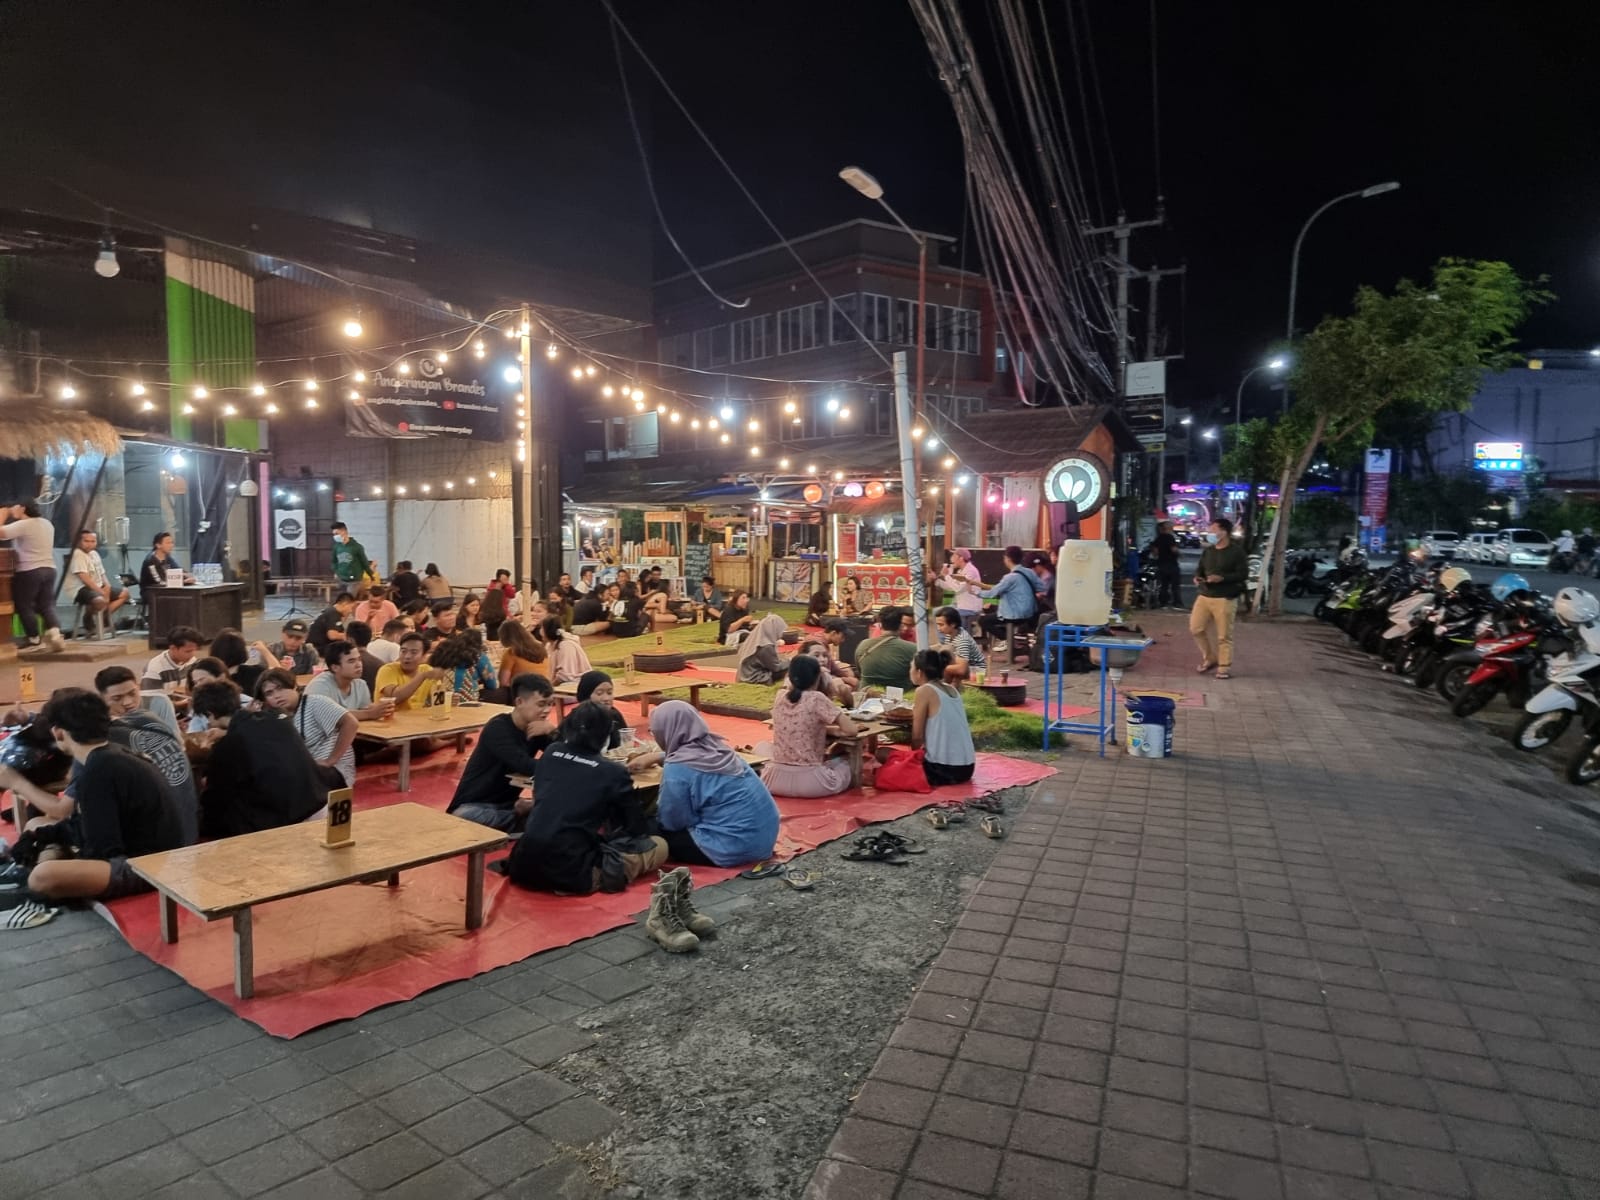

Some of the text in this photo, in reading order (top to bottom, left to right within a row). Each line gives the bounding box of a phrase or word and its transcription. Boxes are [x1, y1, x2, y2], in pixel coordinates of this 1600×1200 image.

[442, 377, 485, 396] Brandes
[433, 691, 445, 706] 20
[328, 799, 352, 827] 18
